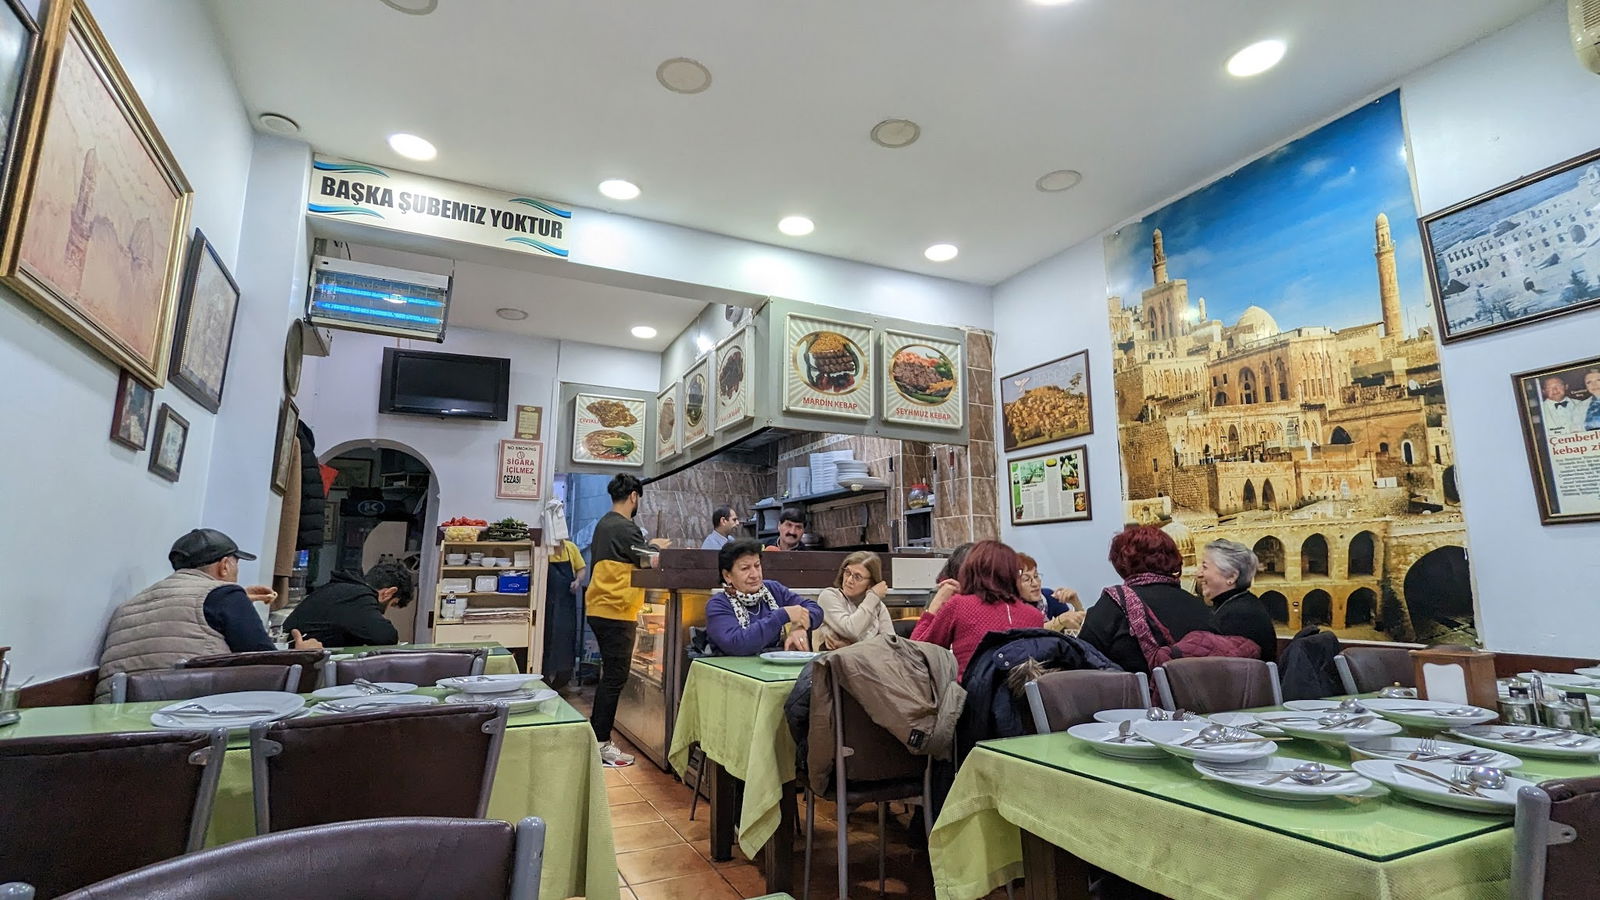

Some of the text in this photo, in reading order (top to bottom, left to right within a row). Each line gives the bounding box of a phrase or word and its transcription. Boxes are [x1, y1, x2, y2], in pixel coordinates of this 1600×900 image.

[320, 176, 394, 206] BAŞKA
[491, 208, 563, 239] YOKTUR
[834, 400, 858, 410] KEBAP
[929, 411, 952, 420] KEBAP
[1552, 445, 1588, 456] kebap
[507, 457, 535, 467] SİGARA
[506, 466, 534, 475] İÇİLMEZ
[503, 475, 522, 484] CEZASI
